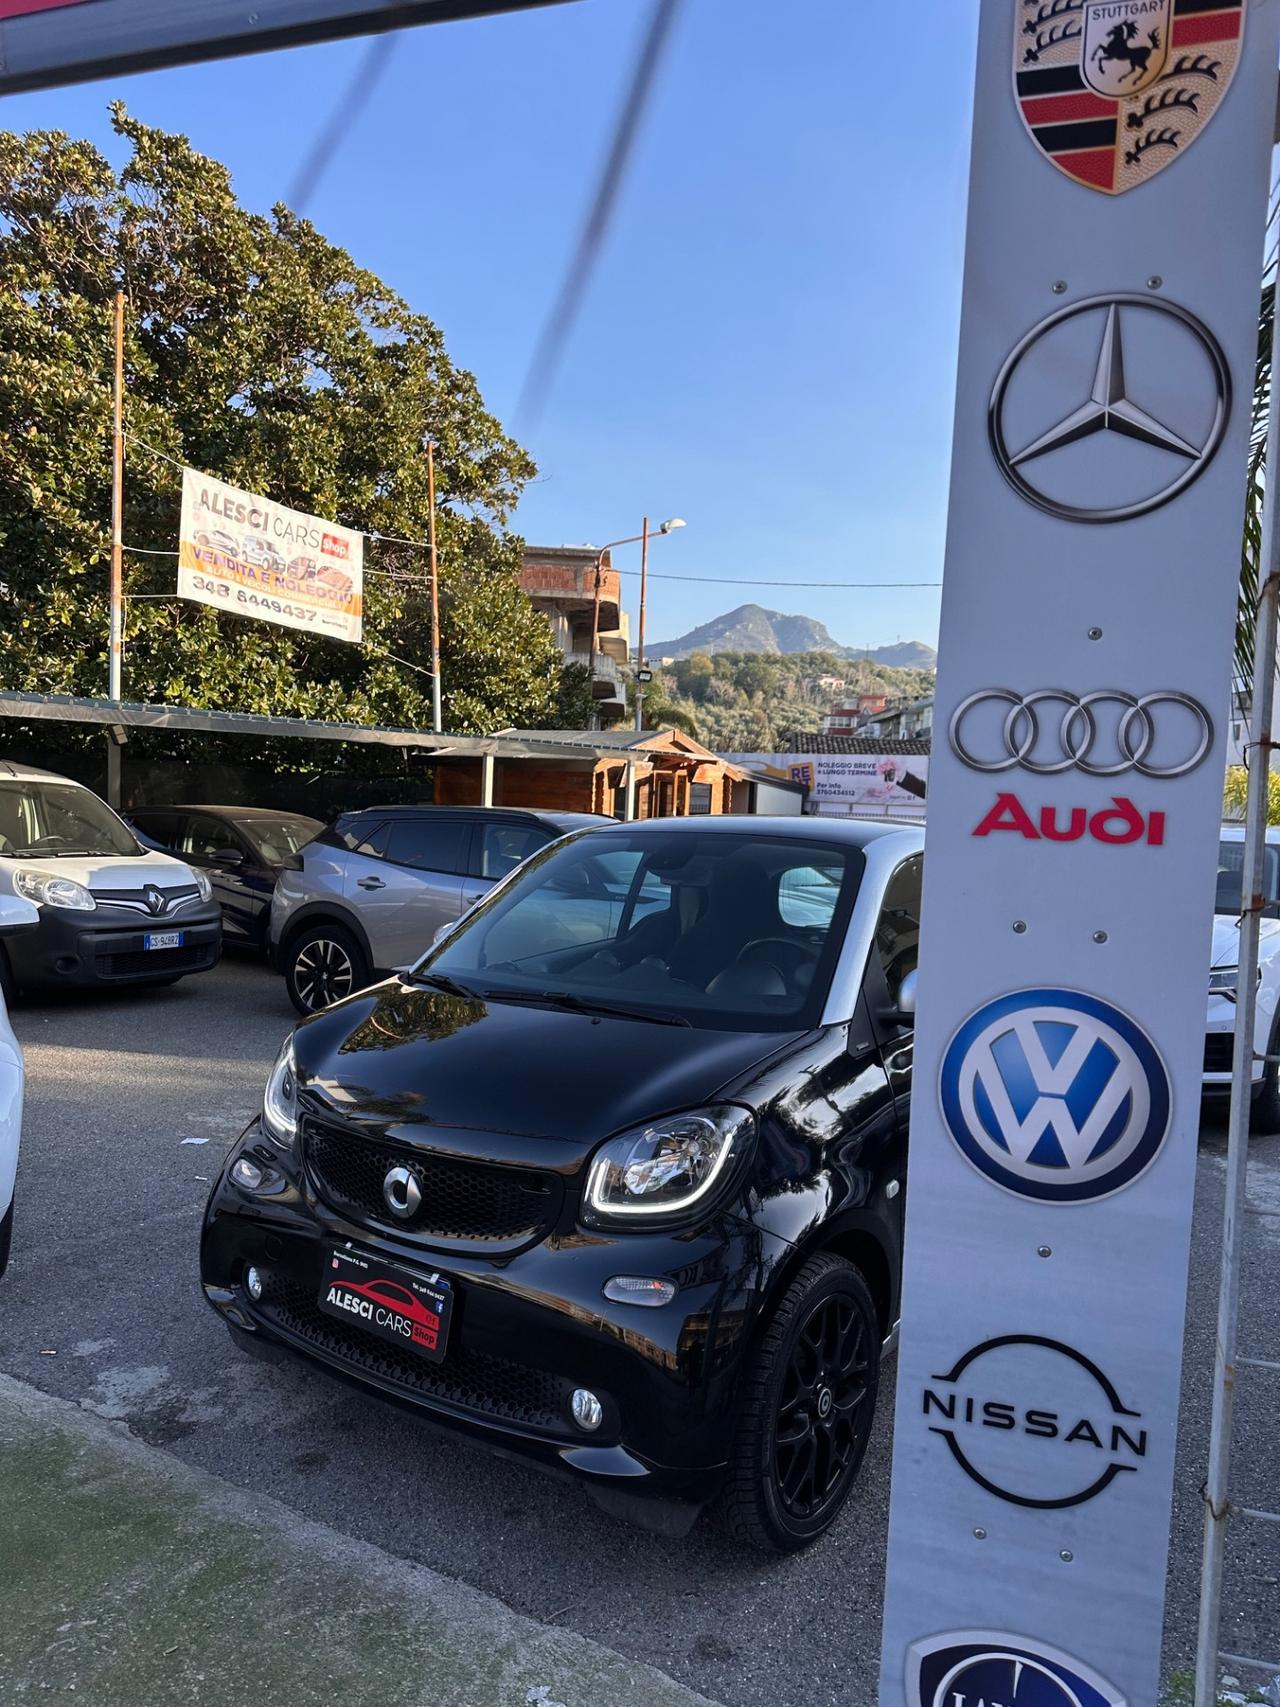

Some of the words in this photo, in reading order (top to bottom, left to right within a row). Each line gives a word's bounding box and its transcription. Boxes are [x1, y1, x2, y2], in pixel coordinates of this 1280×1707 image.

[1092, 1, 1164, 20] STUTTGART
[200, 488, 269, 532] ALESCI
[273, 517, 320, 549] CARS
[322, 538, 347, 557] Shop
[192, 546, 256, 580] VENDITA
[261, 571, 270, 584] E
[275, 576, 352, 604] NOLEGGIO
[192, 576, 230, 599] 348
[791, 766, 810, 779] RE
[971, 793, 1165, 846] Audi
[326, 1287, 373, 1320] ALESCI
[376, 1308, 411, 1337] CARS
[414, 1328, 434, 1345] Shop
[923, 1389, 1147, 1456] NISSAN
